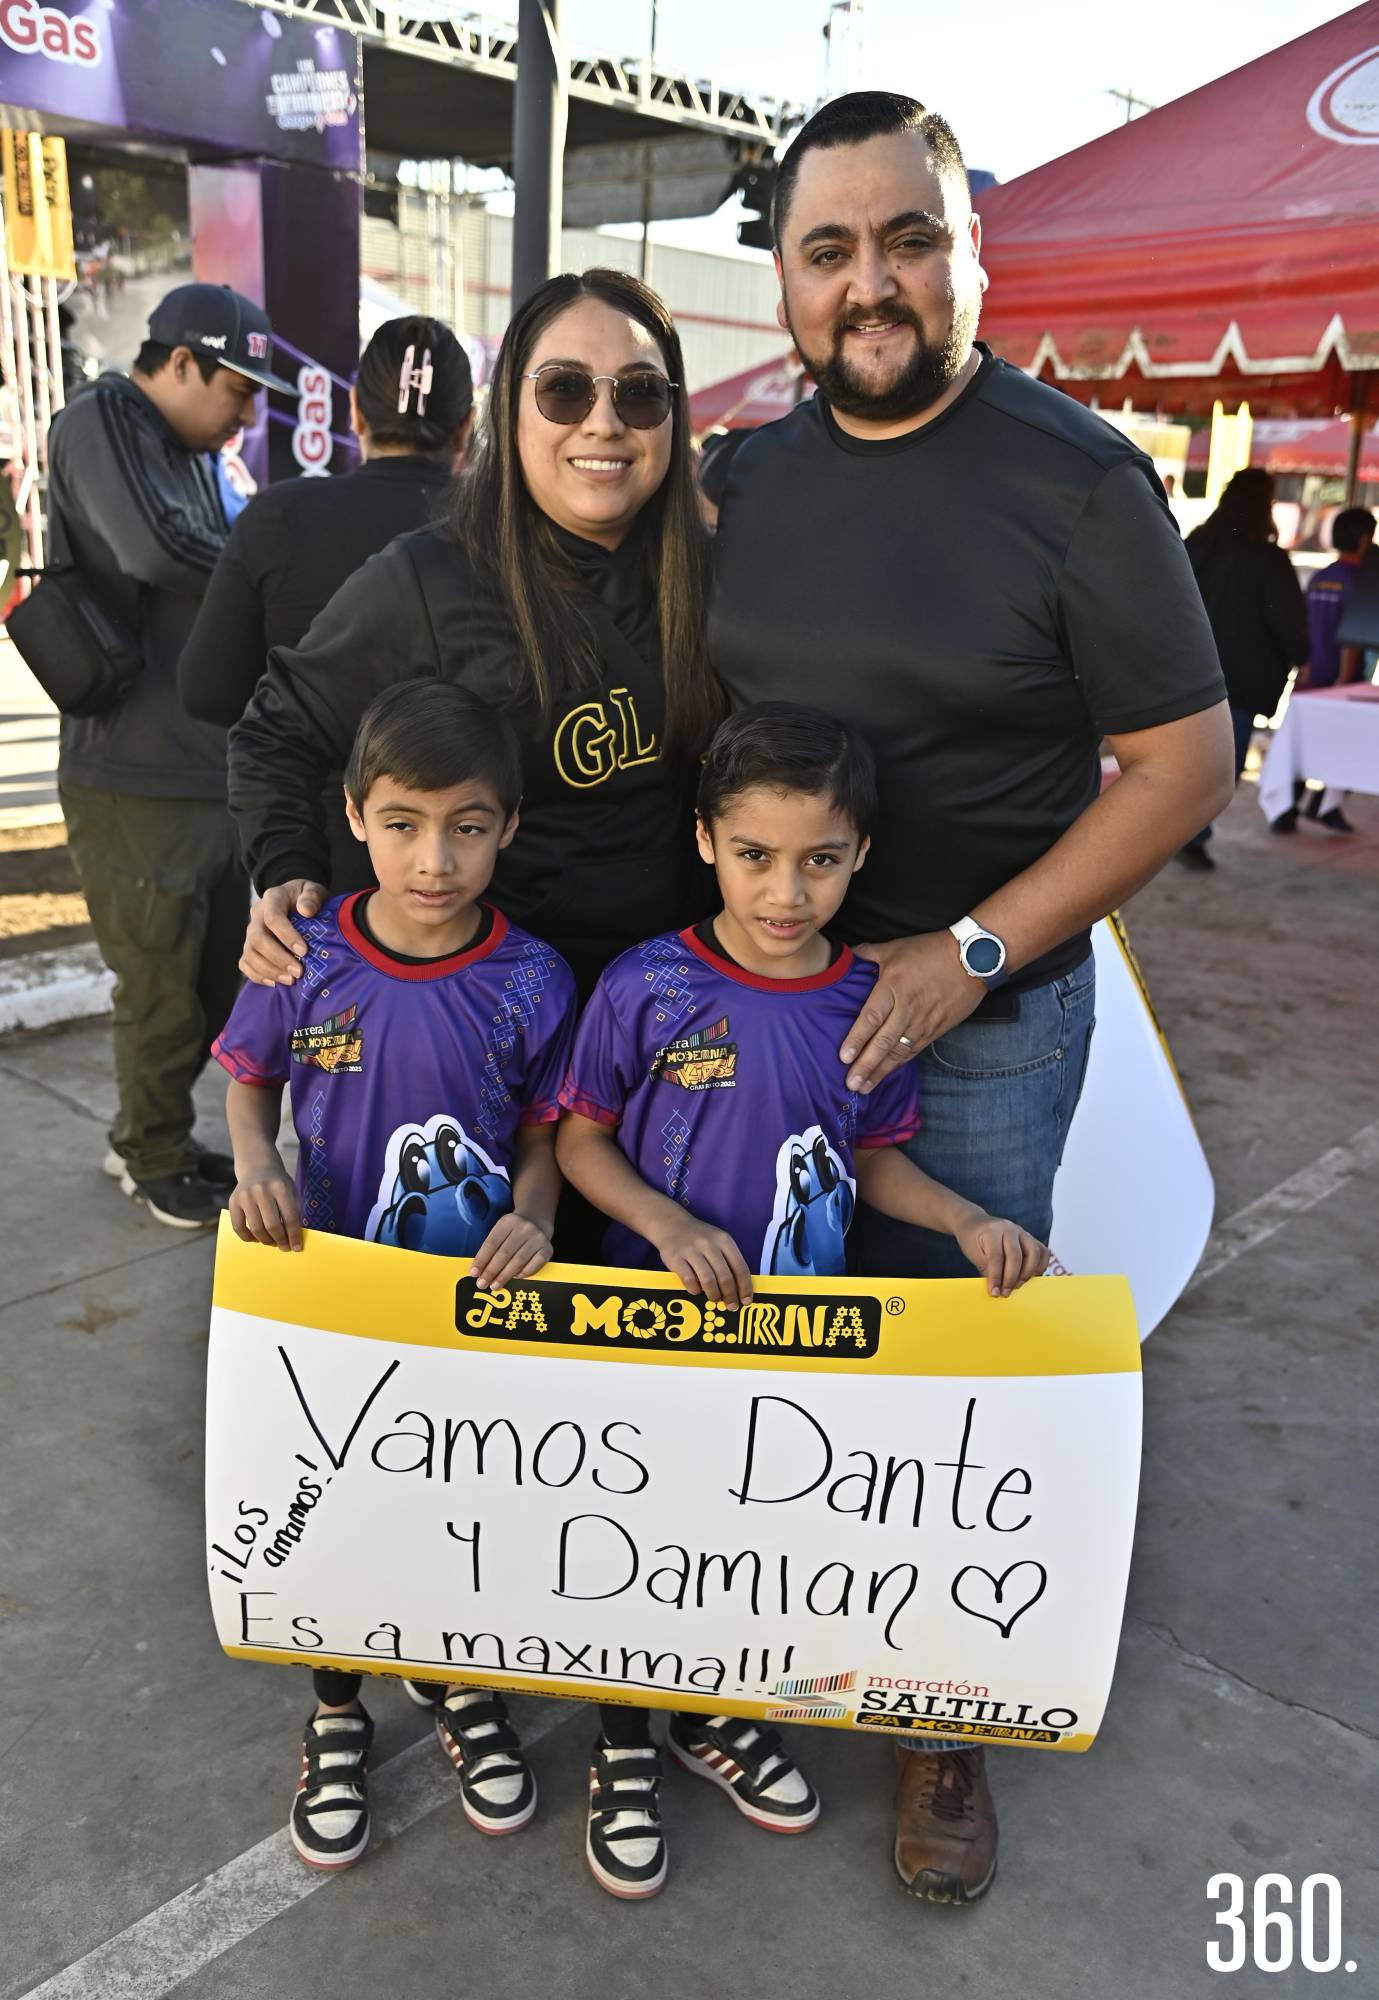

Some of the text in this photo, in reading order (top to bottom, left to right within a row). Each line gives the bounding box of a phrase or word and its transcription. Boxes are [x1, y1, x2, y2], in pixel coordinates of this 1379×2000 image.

[0, 0, 97, 60] Gas
[299, 374, 326, 463] Gas
[554, 688, 663, 788] GL
[293, 1025, 325, 1037] arrera
[466, 1287, 548, 1334] LA
[570, 1292, 868, 1349] MODERNA
[276, 1345, 1034, 1532] Vamos Dante
[263, 1453, 333, 1568] amamos!
[551, 1513, 919, 1651] Damian
[239, 1592, 324, 1648] Es
[364, 1622, 402, 1660] a
[860, 1689, 1079, 1729] SALTILLO
[866, 1674, 990, 1698] maratón
[861, 1714, 900, 1727] LA
[910, 1718, 1053, 1743] MODERNA
